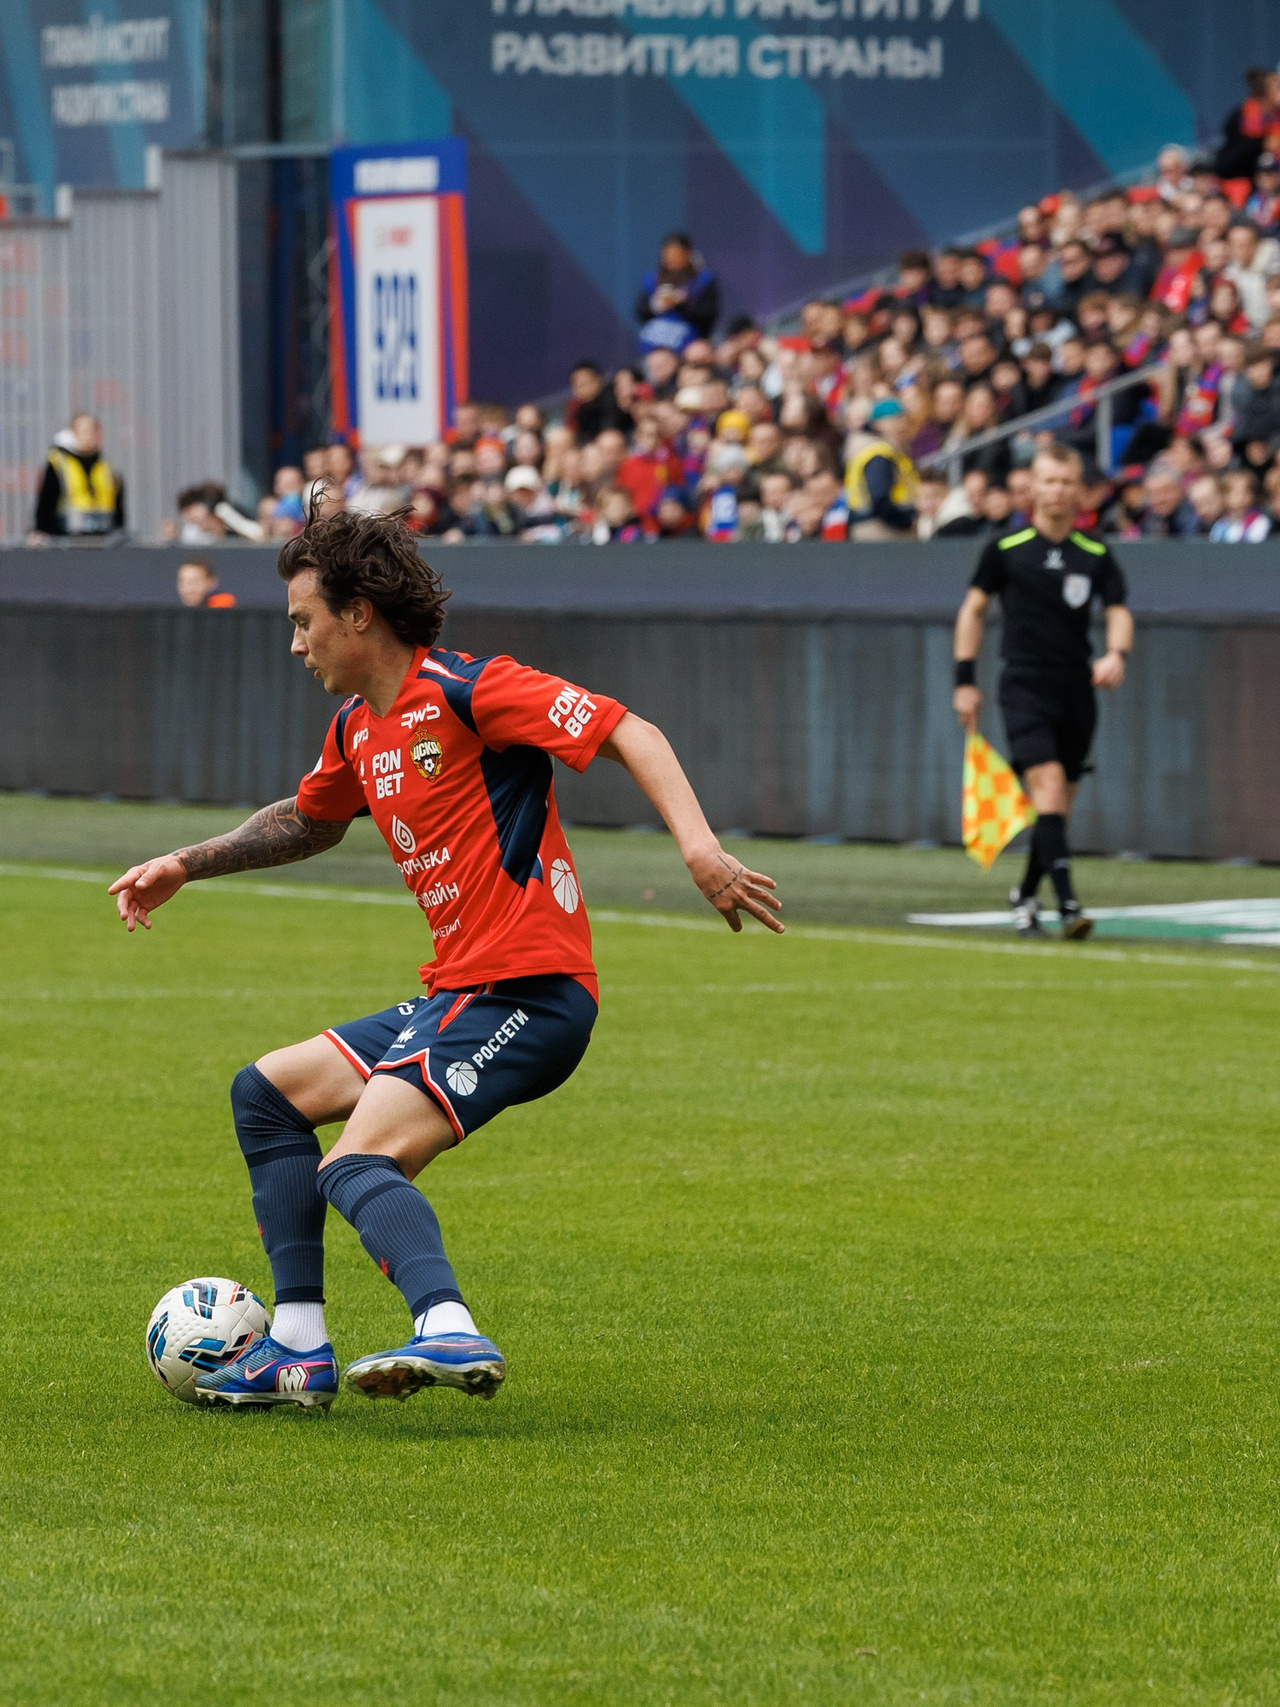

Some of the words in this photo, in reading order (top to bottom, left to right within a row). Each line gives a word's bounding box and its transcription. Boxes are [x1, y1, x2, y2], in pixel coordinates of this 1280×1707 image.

[492, 34, 739, 76] РАЗВИТИЯ
[748, 36, 943, 78] СТРАНЫ
[547, 685, 581, 729] FON
[563, 694, 597, 738] BET
[372, 748, 401, 776] FON
[412, 741, 441, 762] ЦСКА
[375, 771, 404, 800] BET
[471, 1008, 530, 1069] РОССЕТИ
